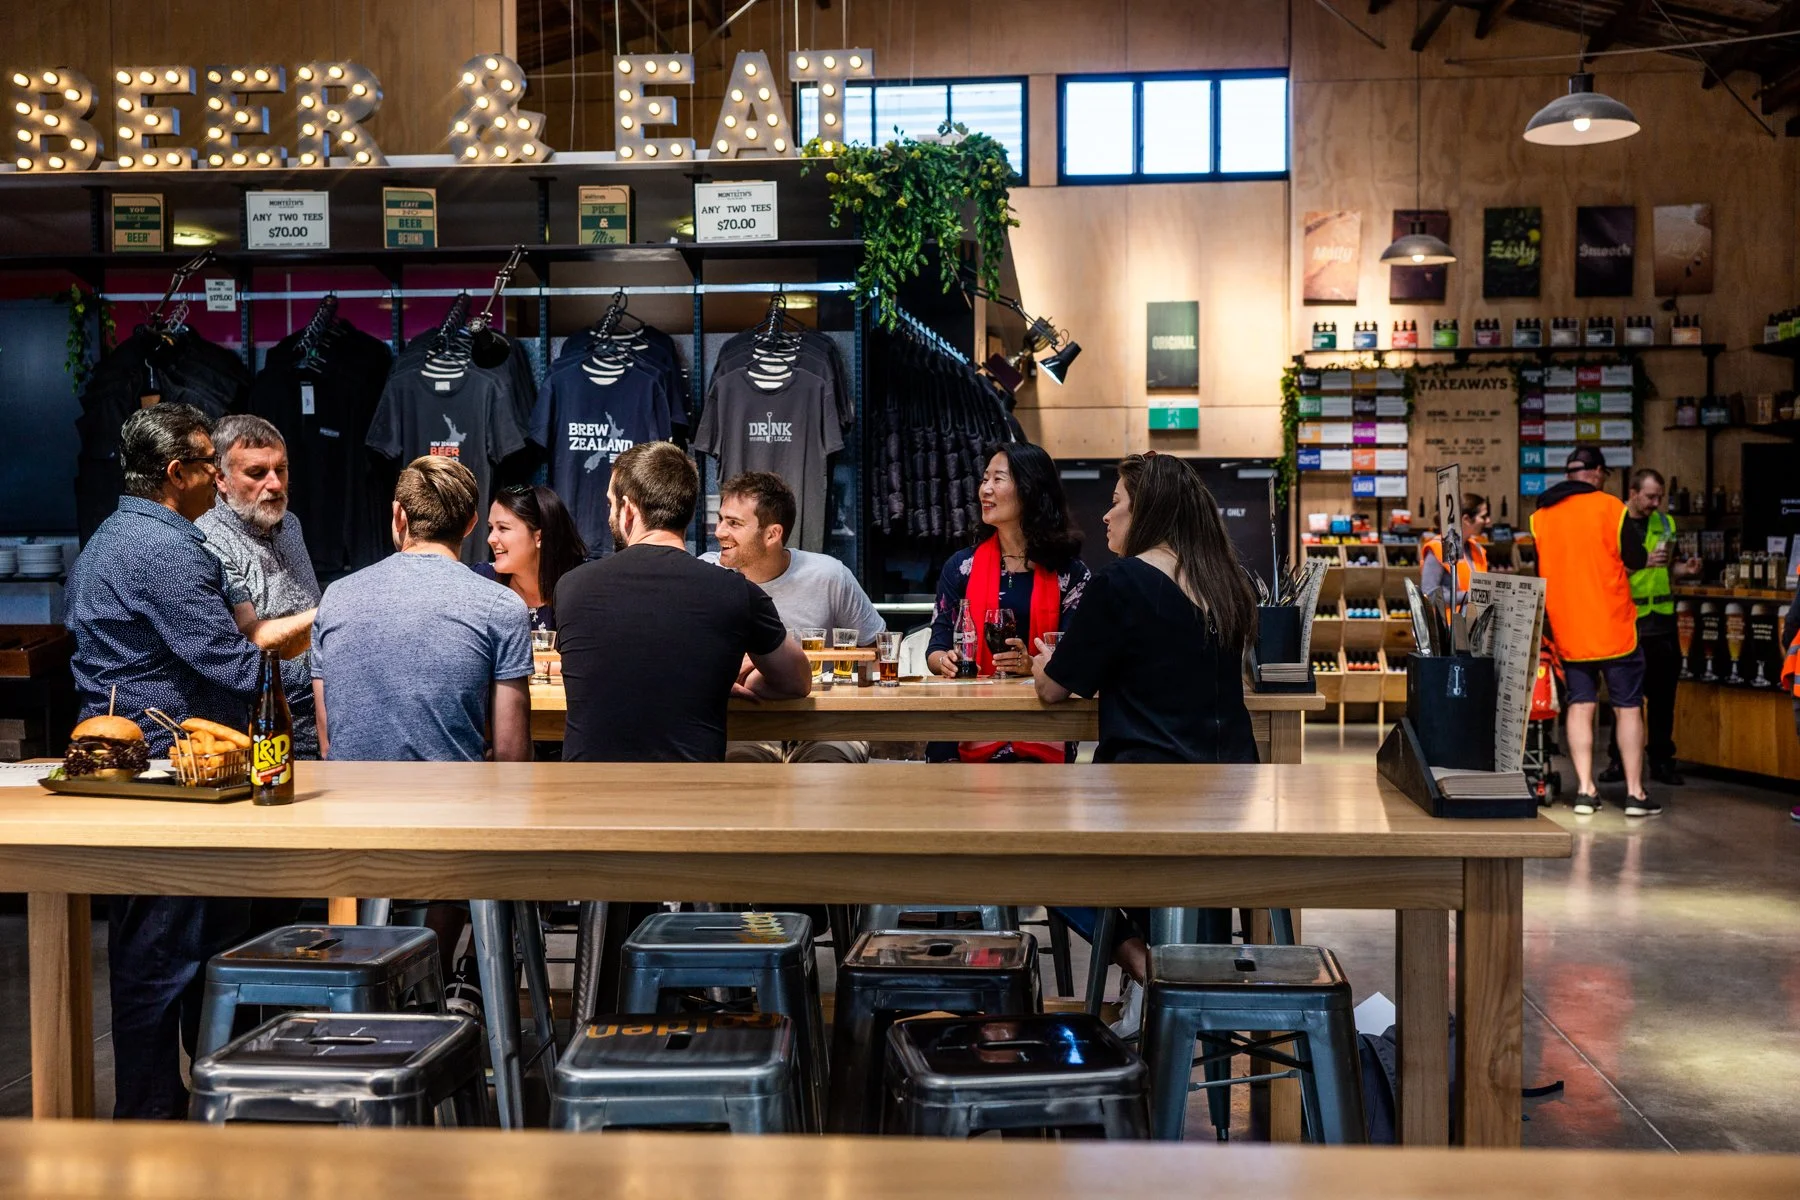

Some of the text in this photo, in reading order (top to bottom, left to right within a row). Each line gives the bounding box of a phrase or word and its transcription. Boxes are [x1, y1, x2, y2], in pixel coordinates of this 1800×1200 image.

[11, 48, 875, 171] BEER & EAT
[592, 206, 616, 214] PICK
[701, 203, 772, 214] ANY TWO TEES
[252, 213, 324, 221] ANY TWO TEES
[399, 218, 422, 228] BEER
[599, 218, 609, 228] &
[717, 218, 756, 230] $70.00
[268, 226, 308, 238] $70.00
[592, 230, 616, 243] Mix
[1420, 378, 1508, 390] TAKEAWAYS
[568, 422, 609, 436] BREW
[568, 436, 633, 453] ZEALAND
[430, 447, 460, 456] BEER
[1445, 493, 1455, 524] 2
[253, 734, 291, 771] L&P
